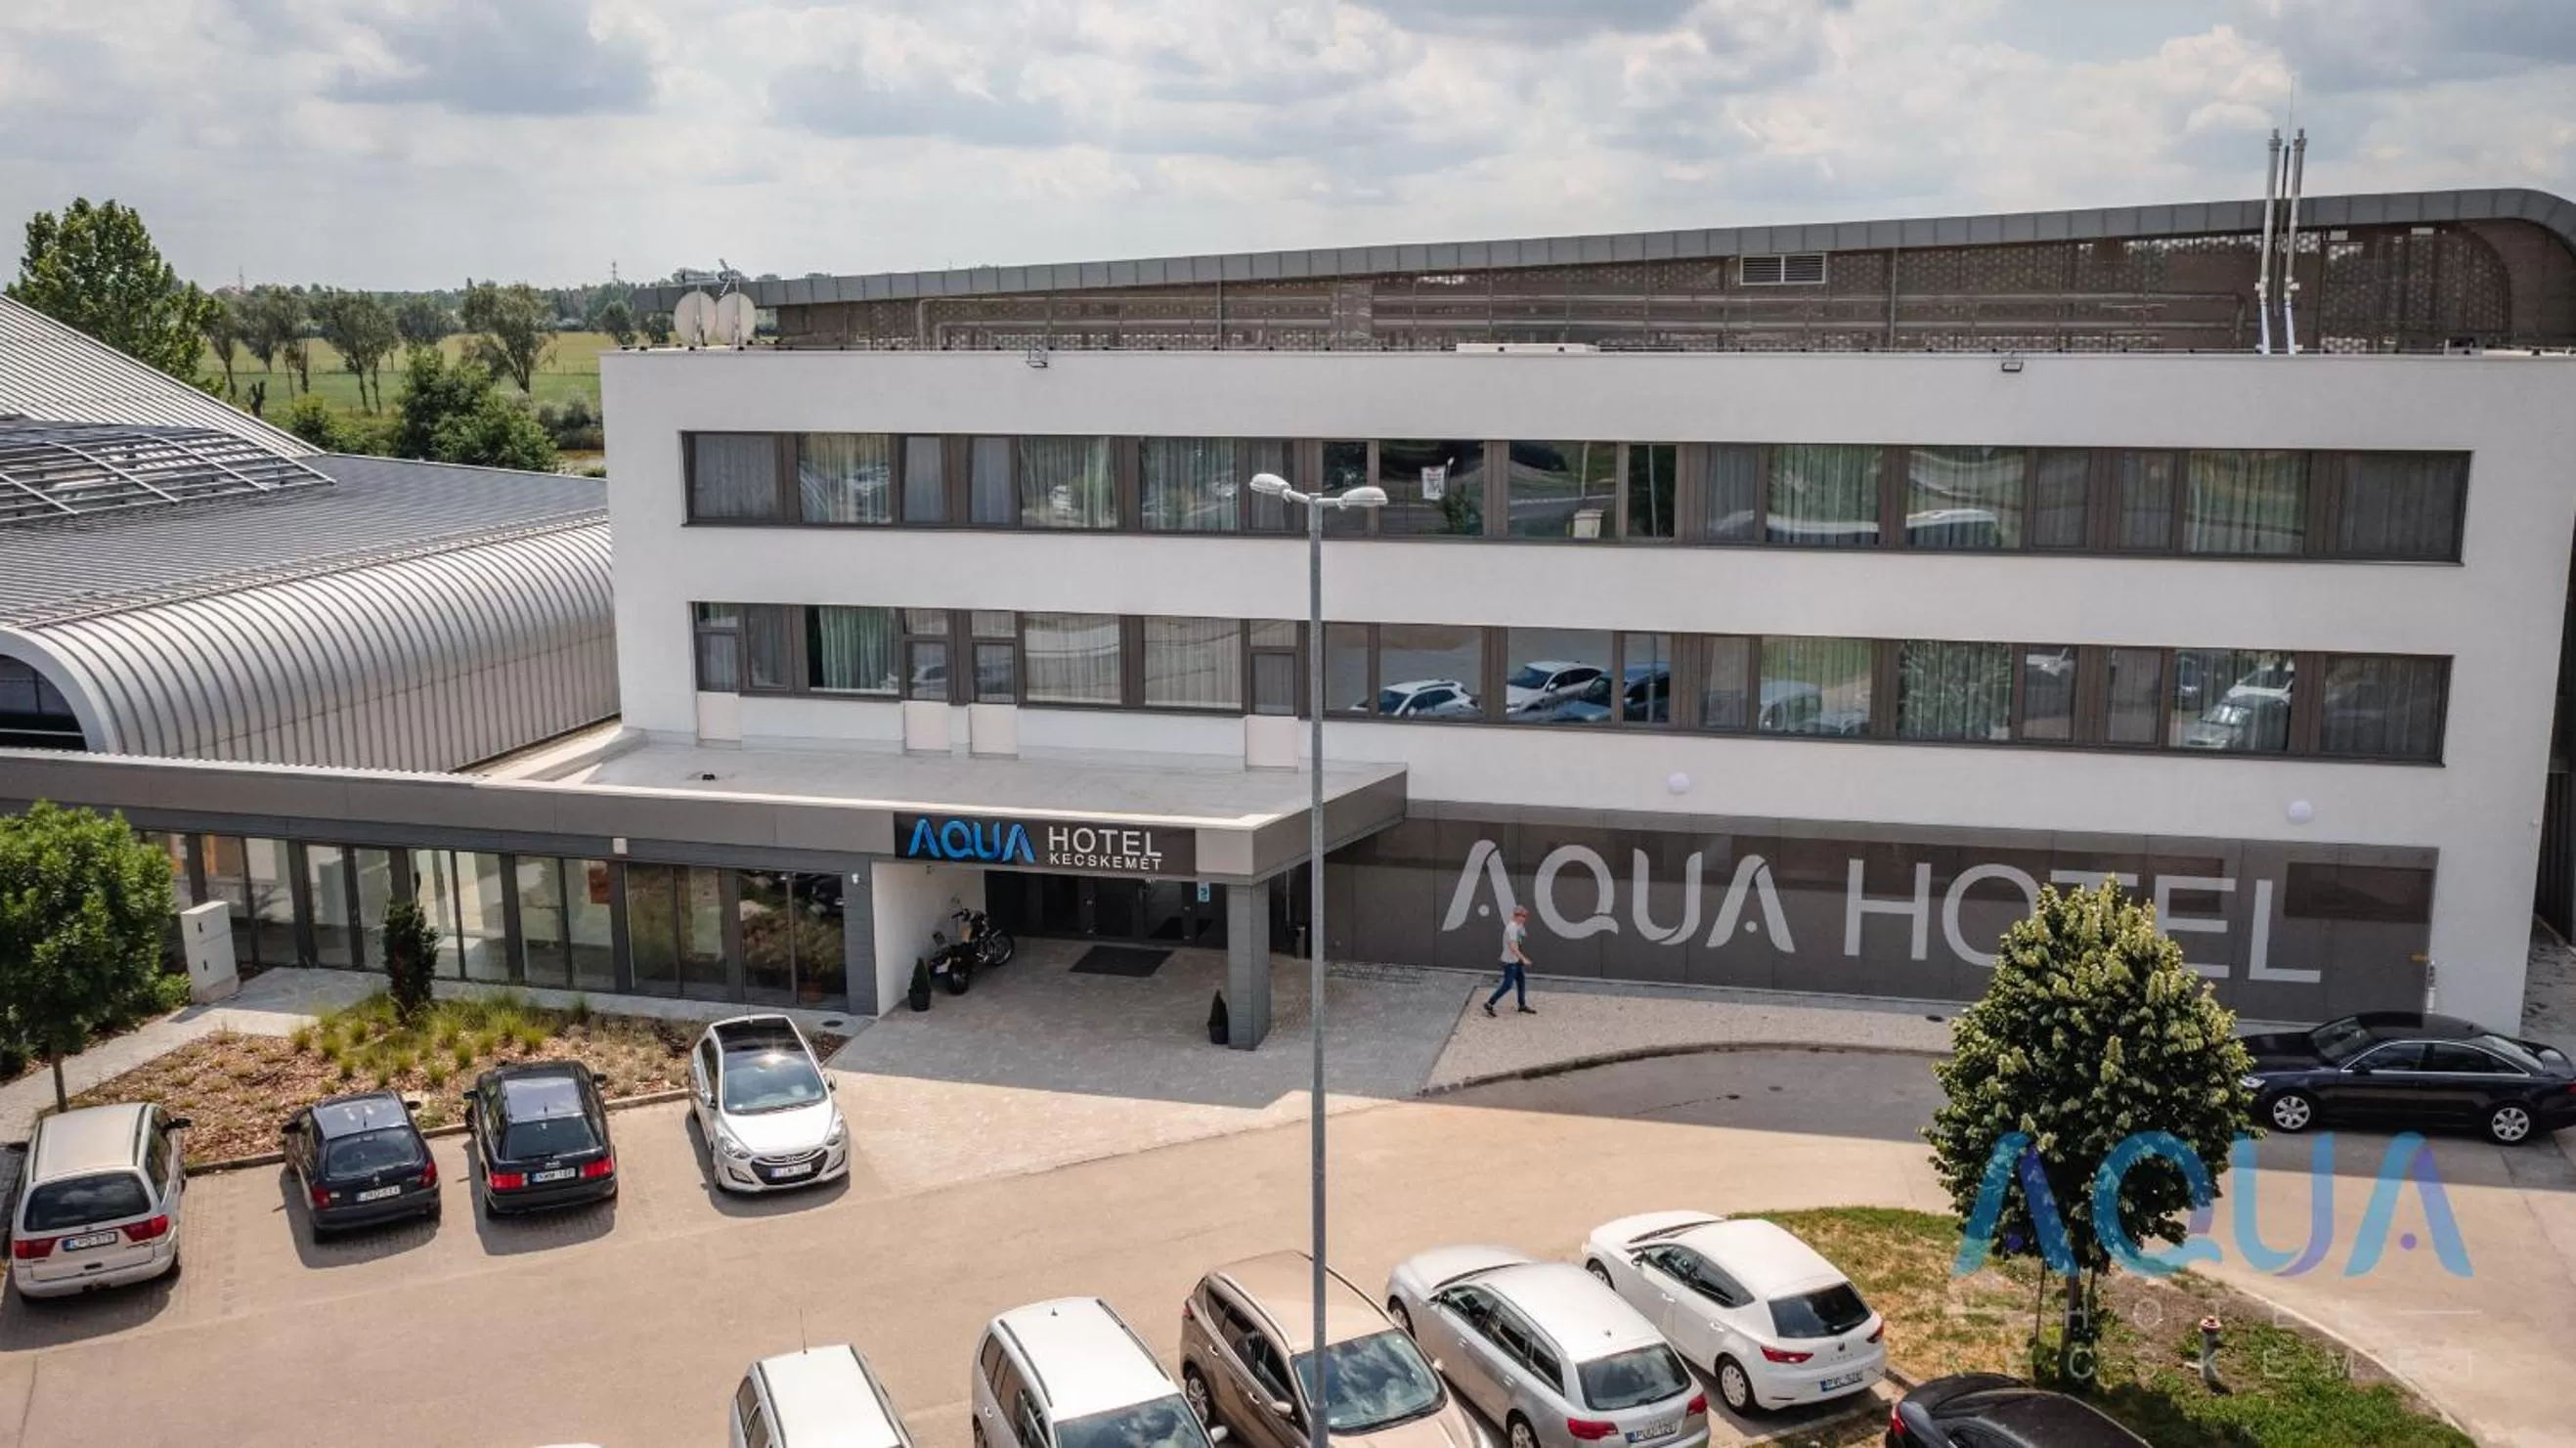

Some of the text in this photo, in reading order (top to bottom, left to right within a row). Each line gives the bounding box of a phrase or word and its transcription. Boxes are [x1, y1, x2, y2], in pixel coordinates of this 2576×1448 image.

[907, 817, 1162, 864] AQUA HOTEL
[1442, 838, 1796, 954] AQUA
